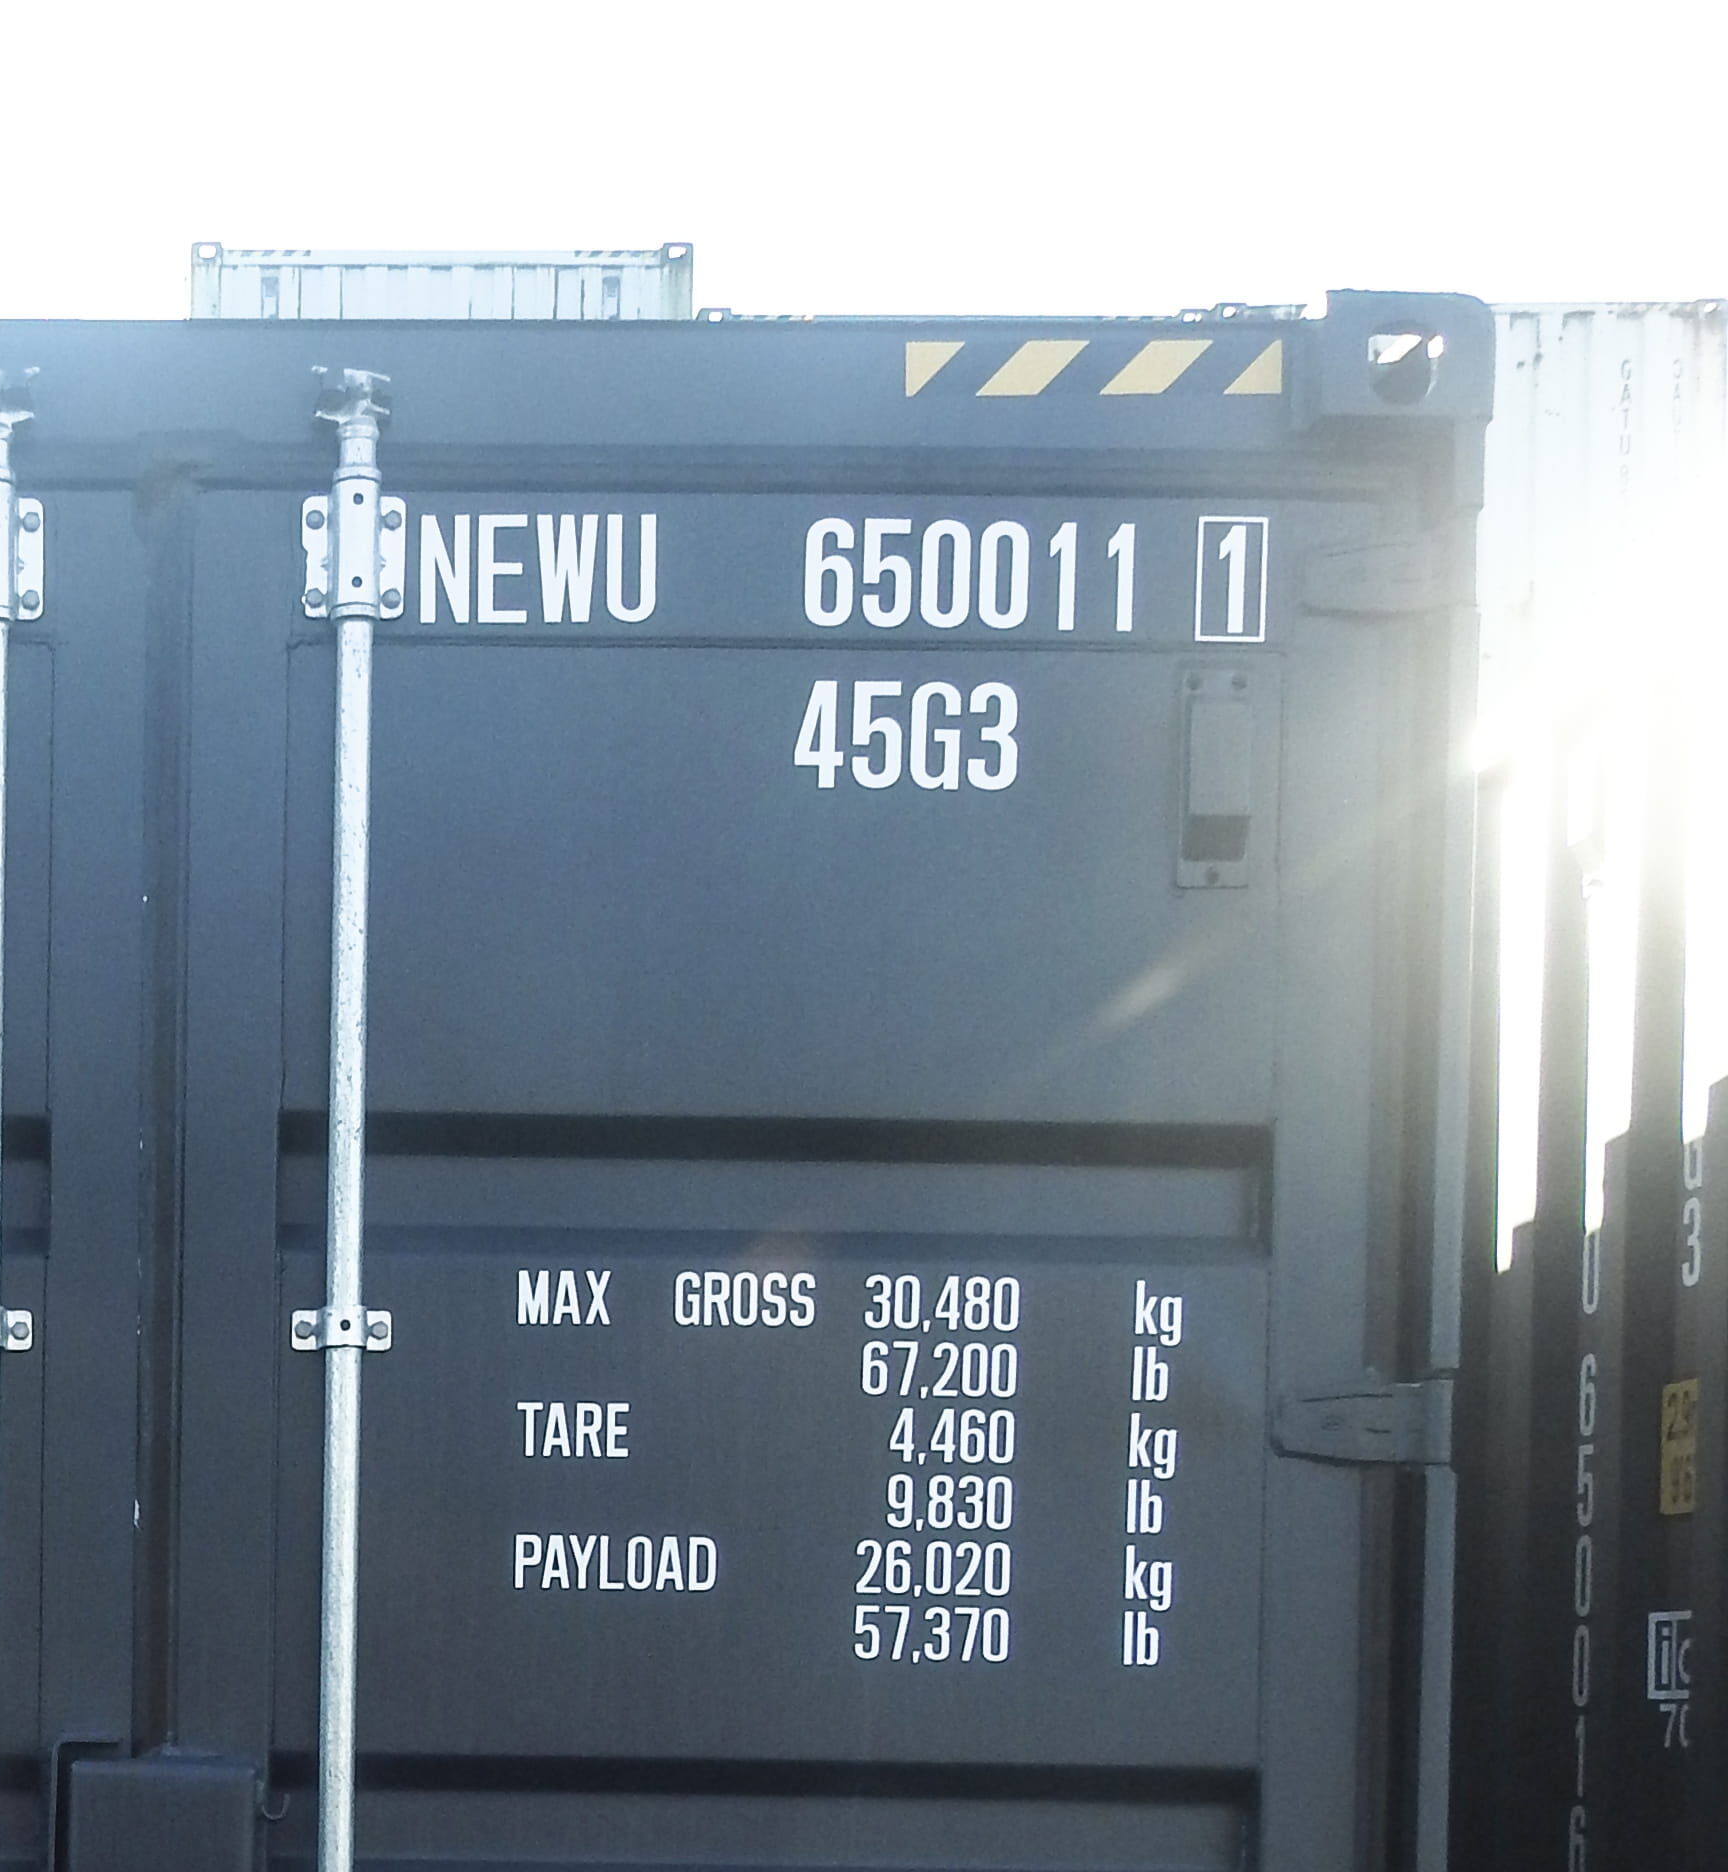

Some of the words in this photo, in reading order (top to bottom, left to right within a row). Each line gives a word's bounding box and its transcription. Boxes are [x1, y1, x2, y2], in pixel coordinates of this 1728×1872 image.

[420, 514, 656, 623] NEWU
[805, 518, 1135, 631] 650011
[1218, 525, 1248, 634] 1
[795, 681, 1017, 790] 45G3
[518, 1270, 611, 1324] MAX
[675, 1272, 815, 1326] GROSS
[865, 1275, 1019, 1332] 30,480
[1134, 1281, 1183, 1346] kg
[863, 1341, 1017, 1398] 67,200
[1132, 1347, 1169, 1402] lb
[517, 1402, 629, 1457] TARE
[890, 1408, 1014, 1465] 4,460
[1128, 1414, 1178, 1478] kg
[888, 1474, 1012, 1531] 9,830
[1126, 1480, 1163, 1534] lb
[515, 1535, 716, 1590] PAYLOAD
[856, 1540, 1010, 1597] 26,020
[1124, 1546, 1173, 1611] kg
[855, 1605, 1009, 1663] 57,370
[1123, 1612, 1159, 1666] lb
